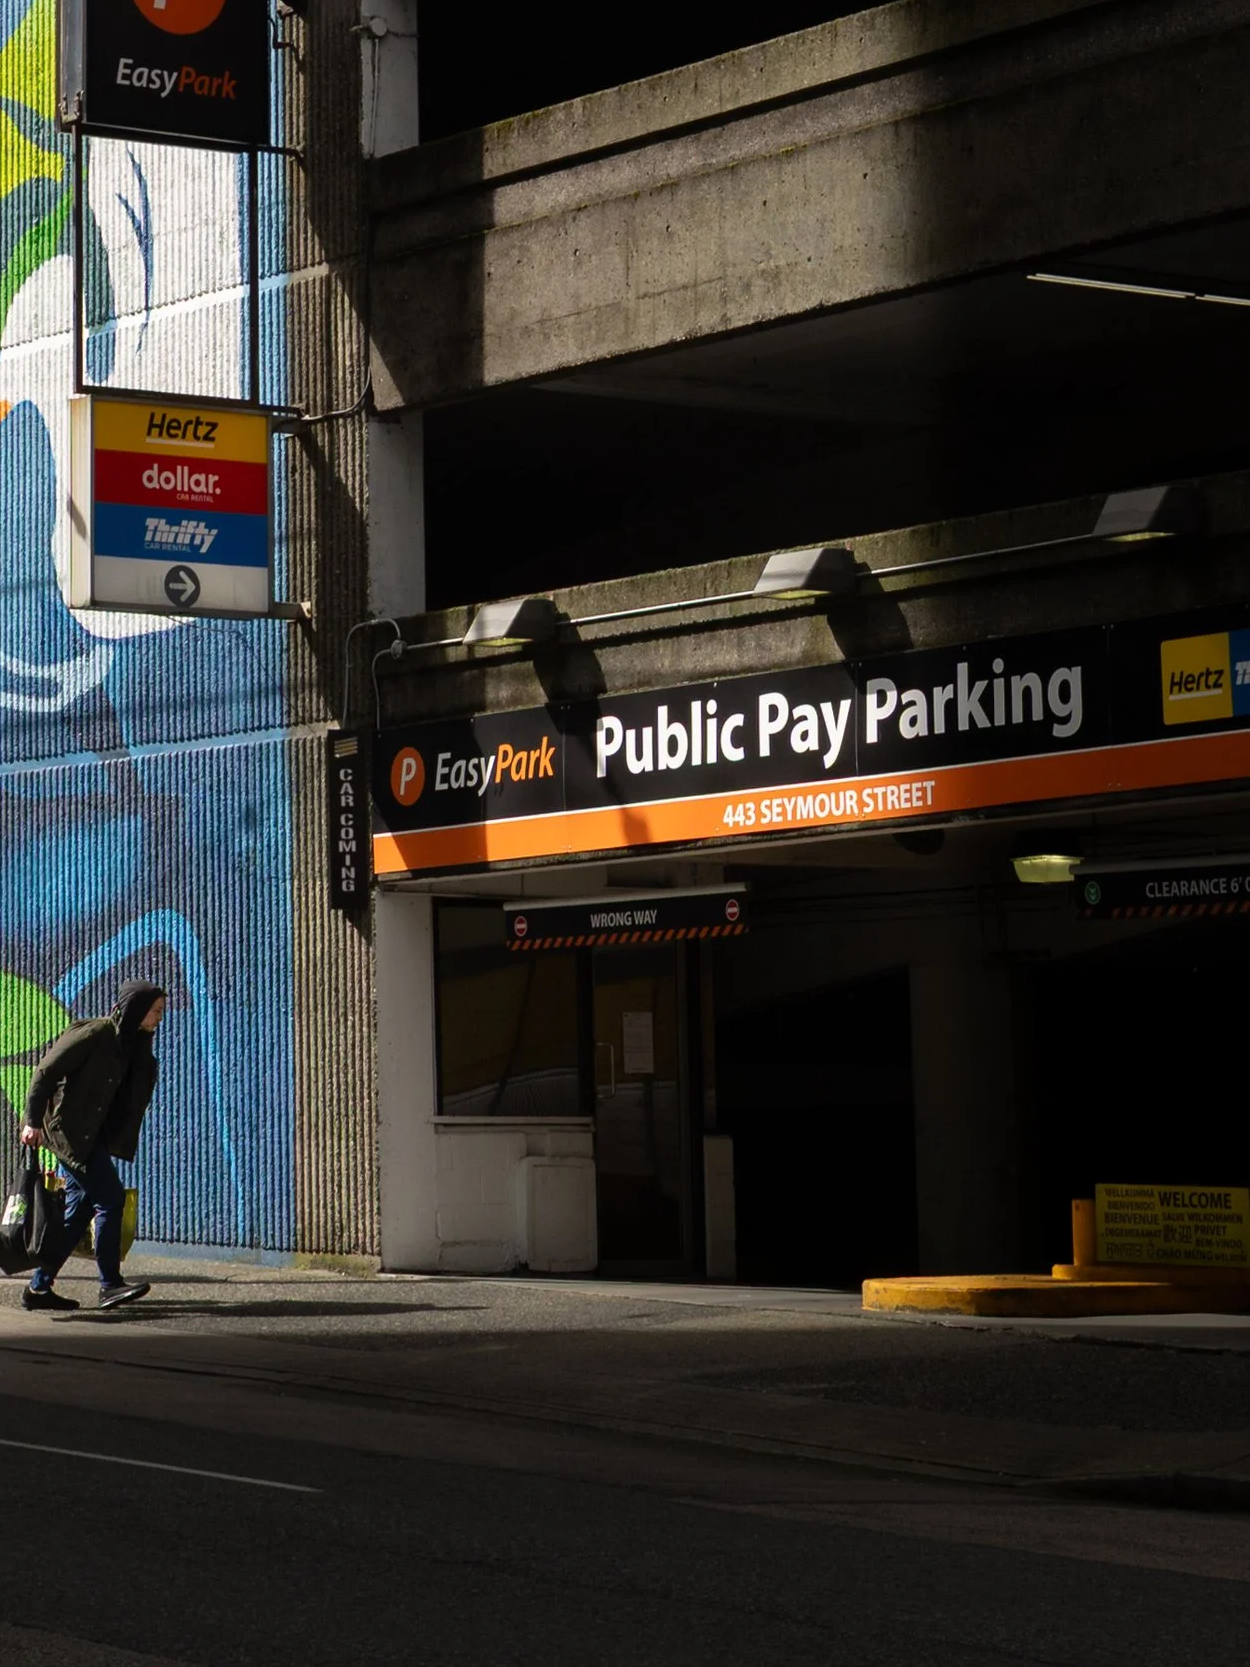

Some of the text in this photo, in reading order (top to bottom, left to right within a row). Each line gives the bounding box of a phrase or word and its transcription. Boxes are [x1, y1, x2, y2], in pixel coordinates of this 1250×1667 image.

[116, 57, 238, 100] EasyPark
[145, 411, 219, 442] Hertz
[144, 517, 219, 554] Thrifty
[144, 541, 191, 553] CAR RENTAL
[1170, 666, 1224, 695] Hertz
[596, 658, 1083, 779] Public Pay Parking
[399, 757, 417, 796] P
[435, 735, 556, 797] EasyPark
[722, 779, 936, 828] 443 SEYMOUR STREET
[338, 768, 356, 892] CAR COMING
[1145, 877, 1228, 899] CLEARANCE
[589, 909, 657, 929] WRONG WAY
[1158, 1191, 1232, 1209] WELCOME
[1104, 1212, 1160, 1225] BIENVENUE
[1194, 1225, 1228, 1236] PRIVET
